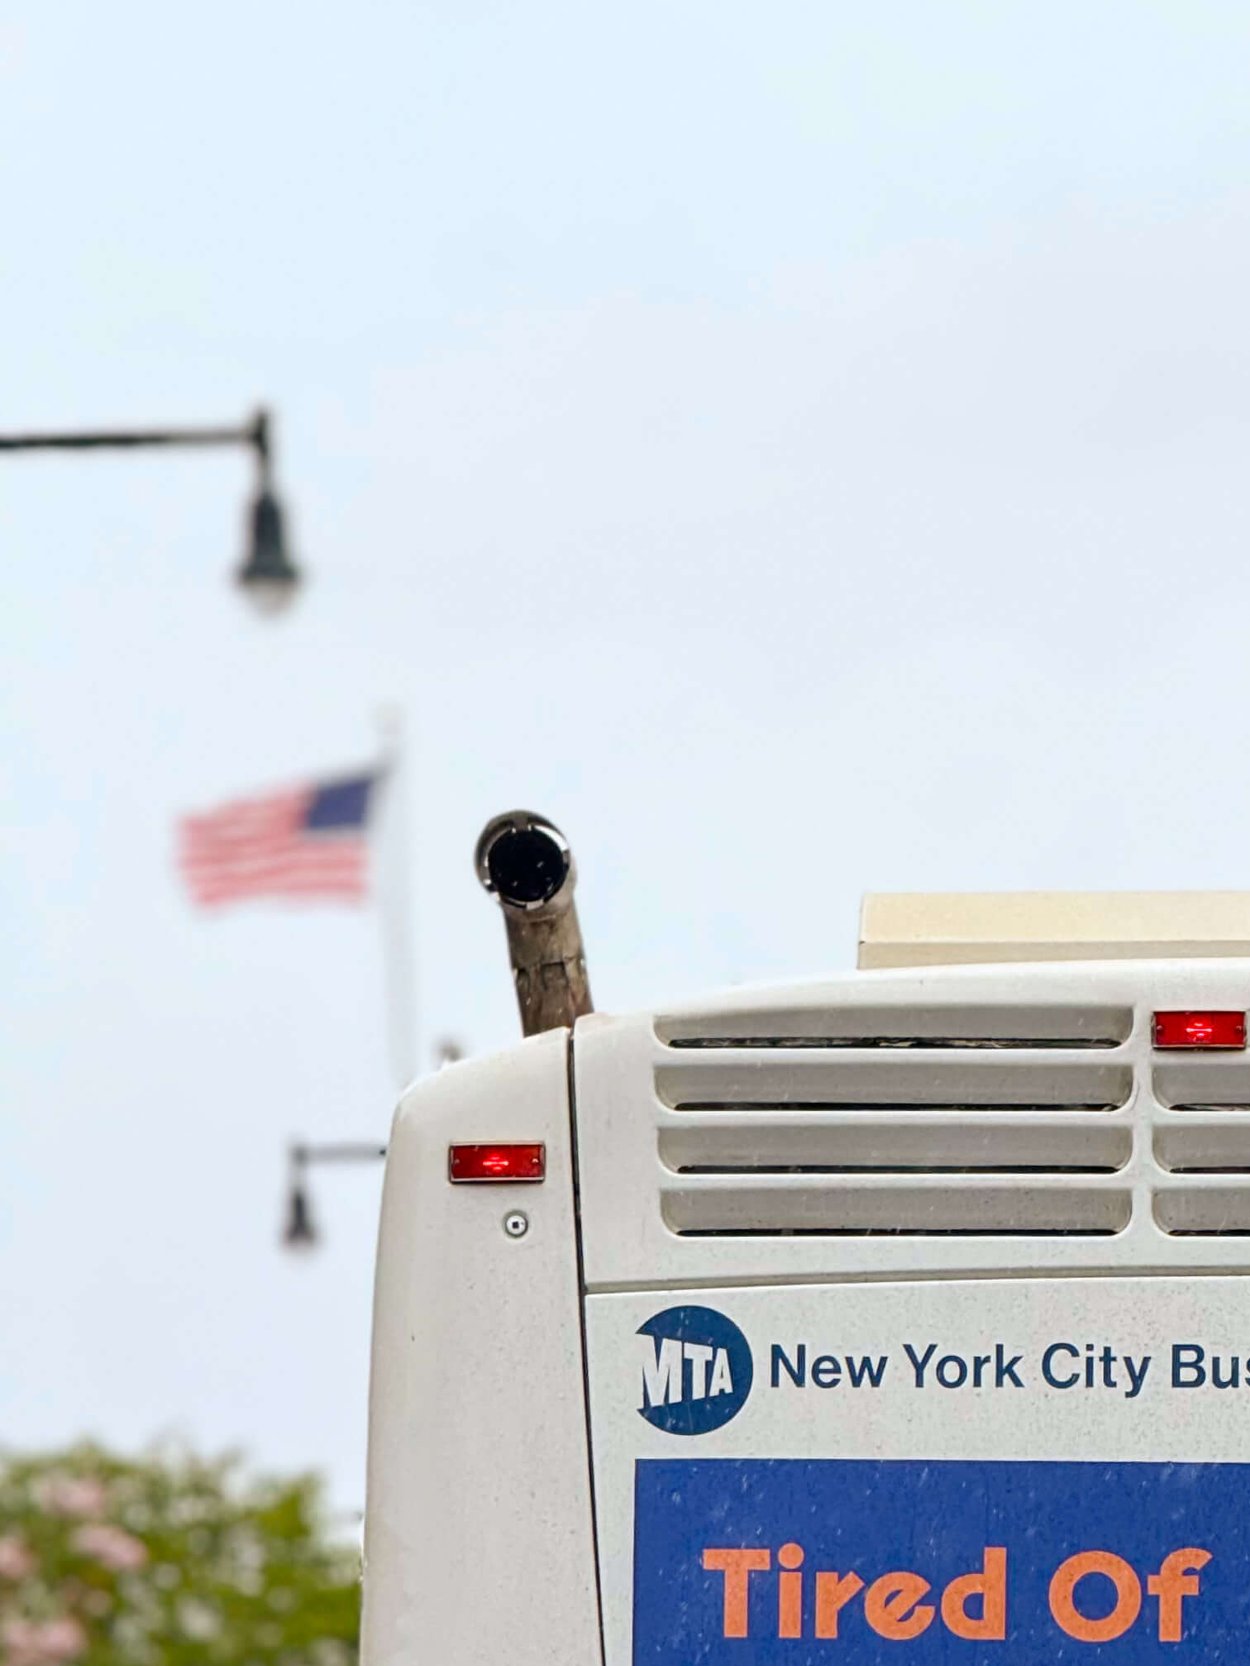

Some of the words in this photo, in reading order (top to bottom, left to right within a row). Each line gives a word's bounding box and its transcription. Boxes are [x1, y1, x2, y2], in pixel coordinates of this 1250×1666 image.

[641, 1333, 734, 1410] MTA
[770, 1343, 888, 1389] New
[902, 1343, 1024, 1388] York
[1040, 1343, 1152, 1398] City
[702, 1542, 1007, 1641] Tired
[1049, 1547, 1213, 1642] Of
